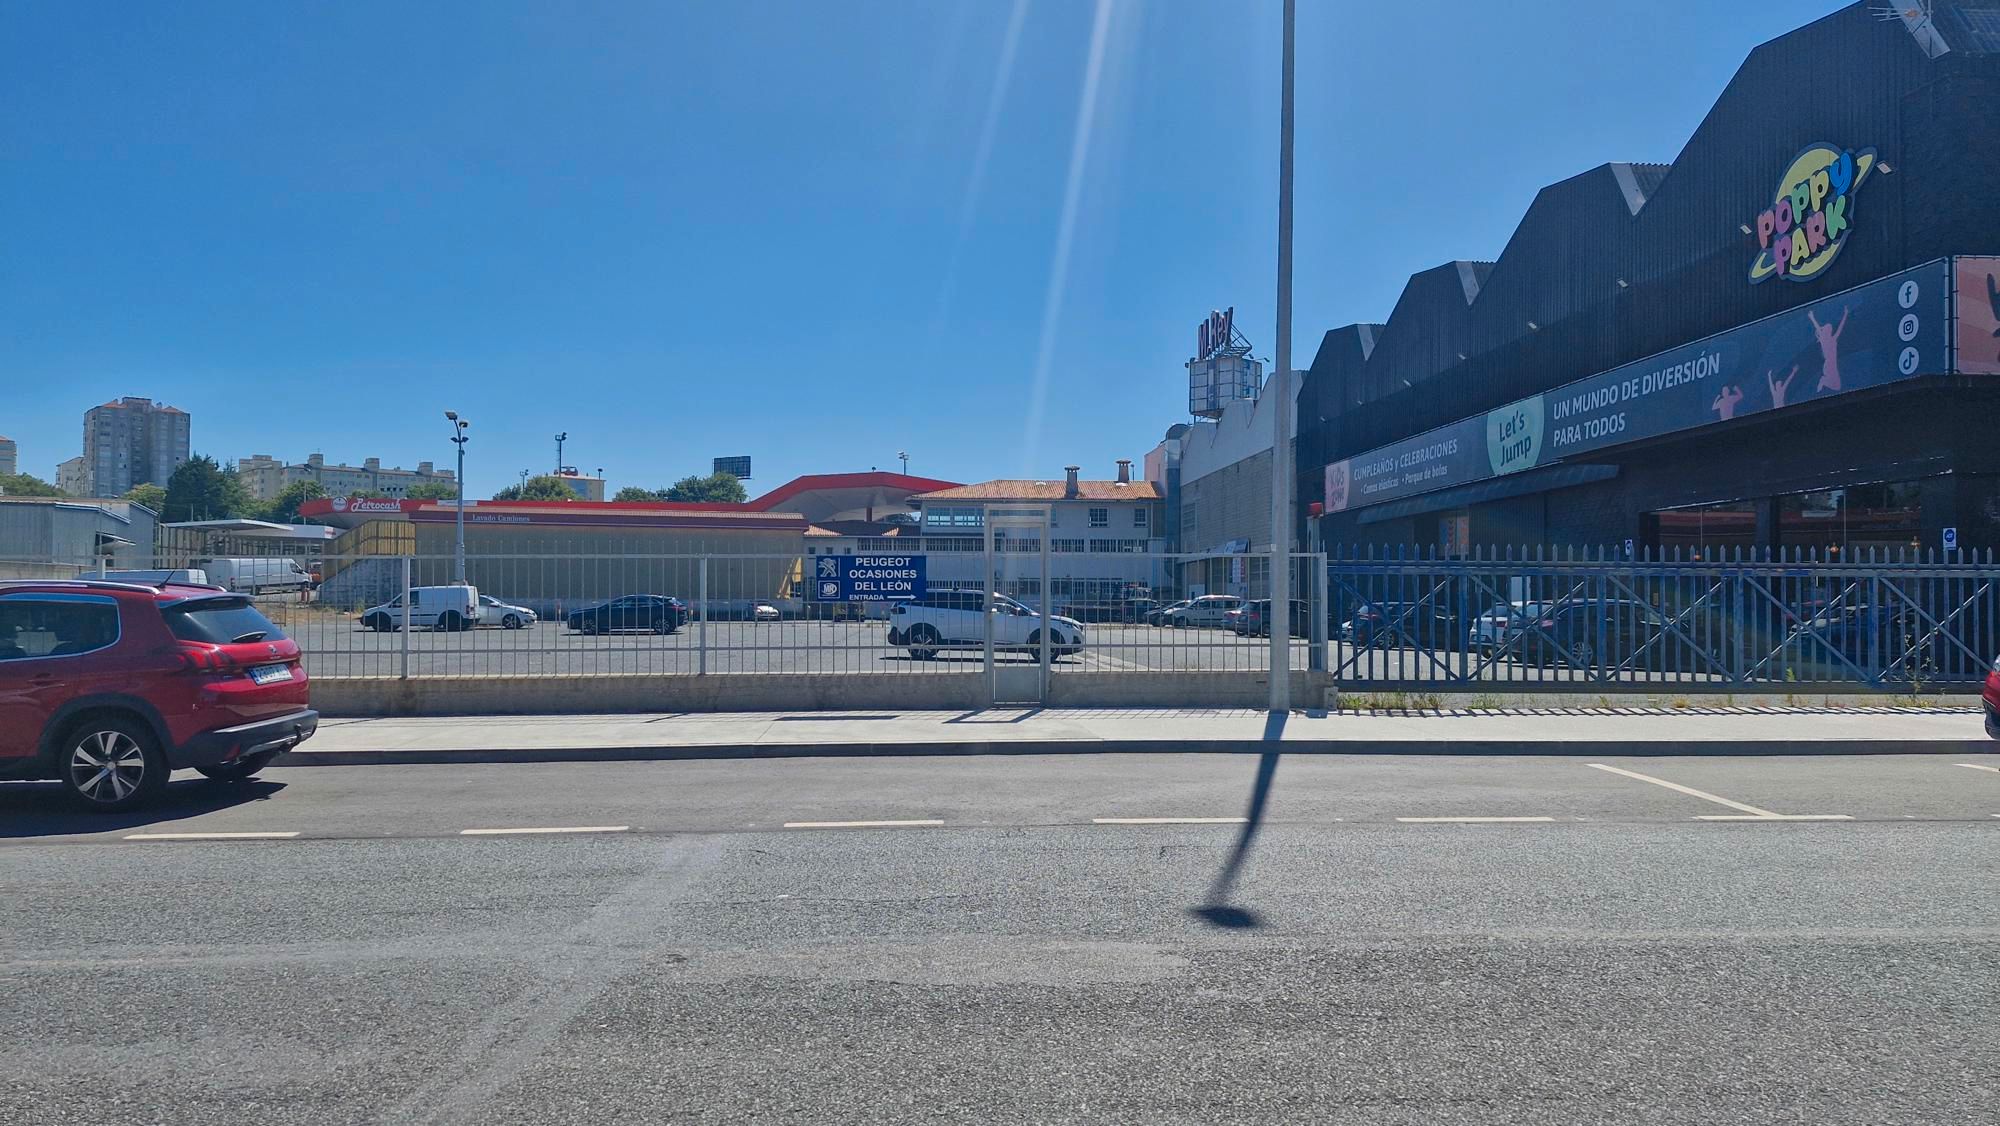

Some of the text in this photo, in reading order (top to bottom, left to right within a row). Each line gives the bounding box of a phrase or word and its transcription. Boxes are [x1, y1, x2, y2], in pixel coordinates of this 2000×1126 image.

[1774, 195, 1847, 275] PARK
[1553, 350, 1720, 420] UN MUNDO DE DIVERSIÓN
[1499, 409, 1525, 443] Let's
[1553, 412, 1626, 448] PARA TODOS
[1354, 457, 1393, 481] CUMPLEAÑOS
[1400, 439, 1458, 468] CELEBRACIONES
[1500, 435, 1532, 467] Jump
[351, 496, 401, 513] Petrocash
[472, 513, 496, 521] Lavado
[849, 569, 917, 579] OCASIONES
[855, 557, 912, 567] PEUGEOT
[855, 579, 912, 591] DEL LEÓN
